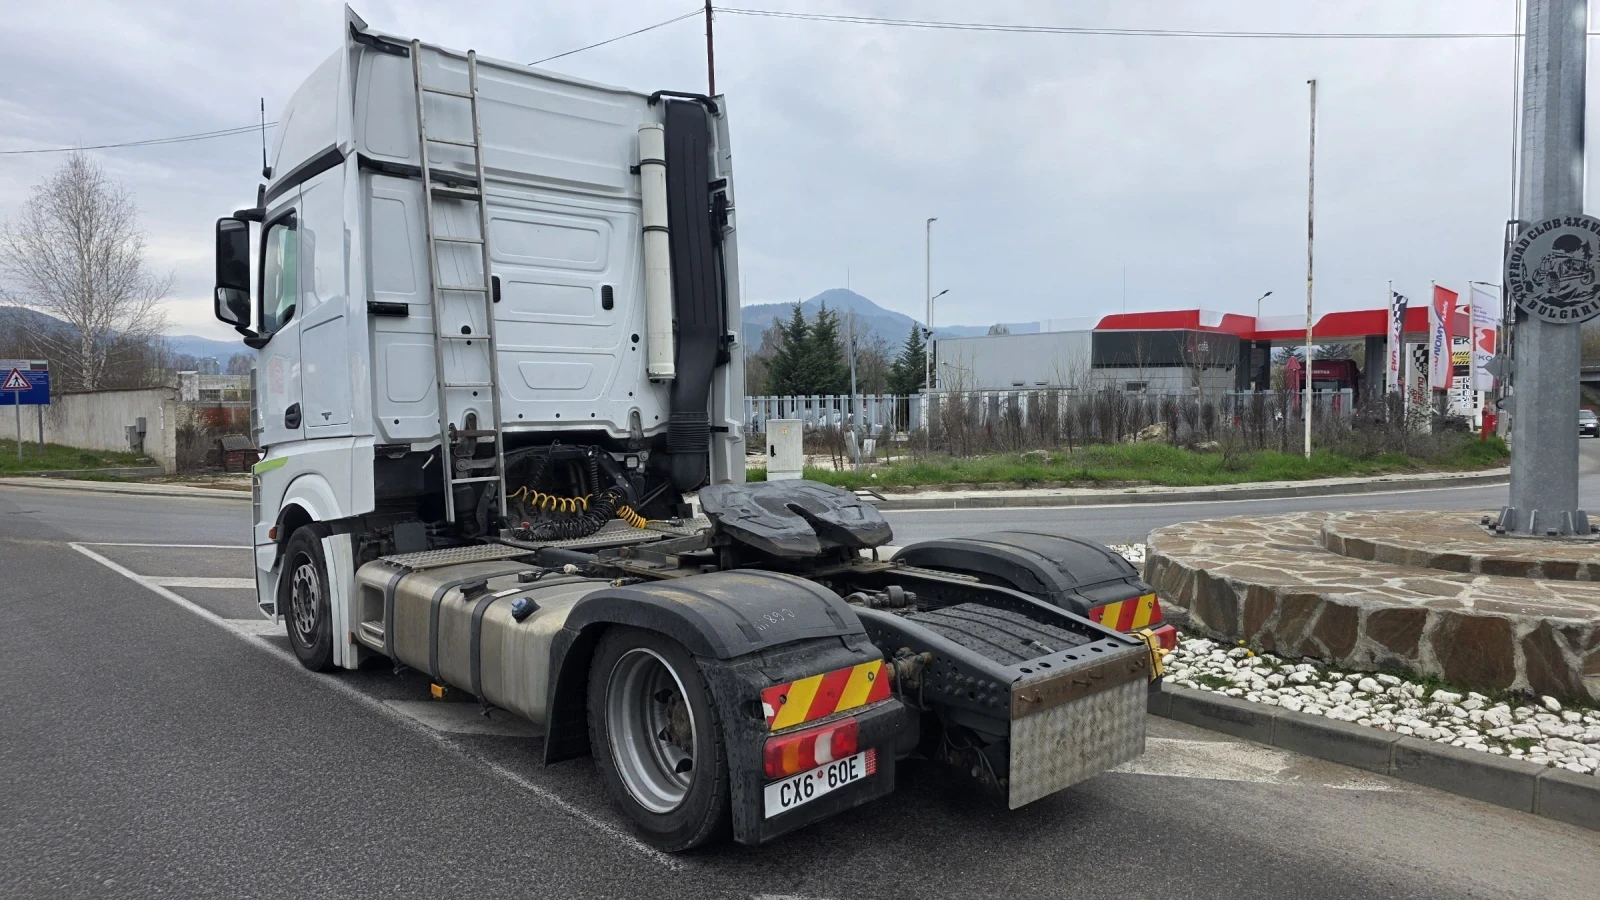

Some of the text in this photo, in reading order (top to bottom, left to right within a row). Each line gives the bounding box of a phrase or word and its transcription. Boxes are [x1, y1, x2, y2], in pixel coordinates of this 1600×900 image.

[1509, 238, 1531, 294] OFFROAD
[1527, 217, 1562, 240] CLUB
[1563, 216, 1590, 230] 4X4
[1526, 297, 1600, 319] BULGARI
[780, 755, 859, 808] CX6 60E
